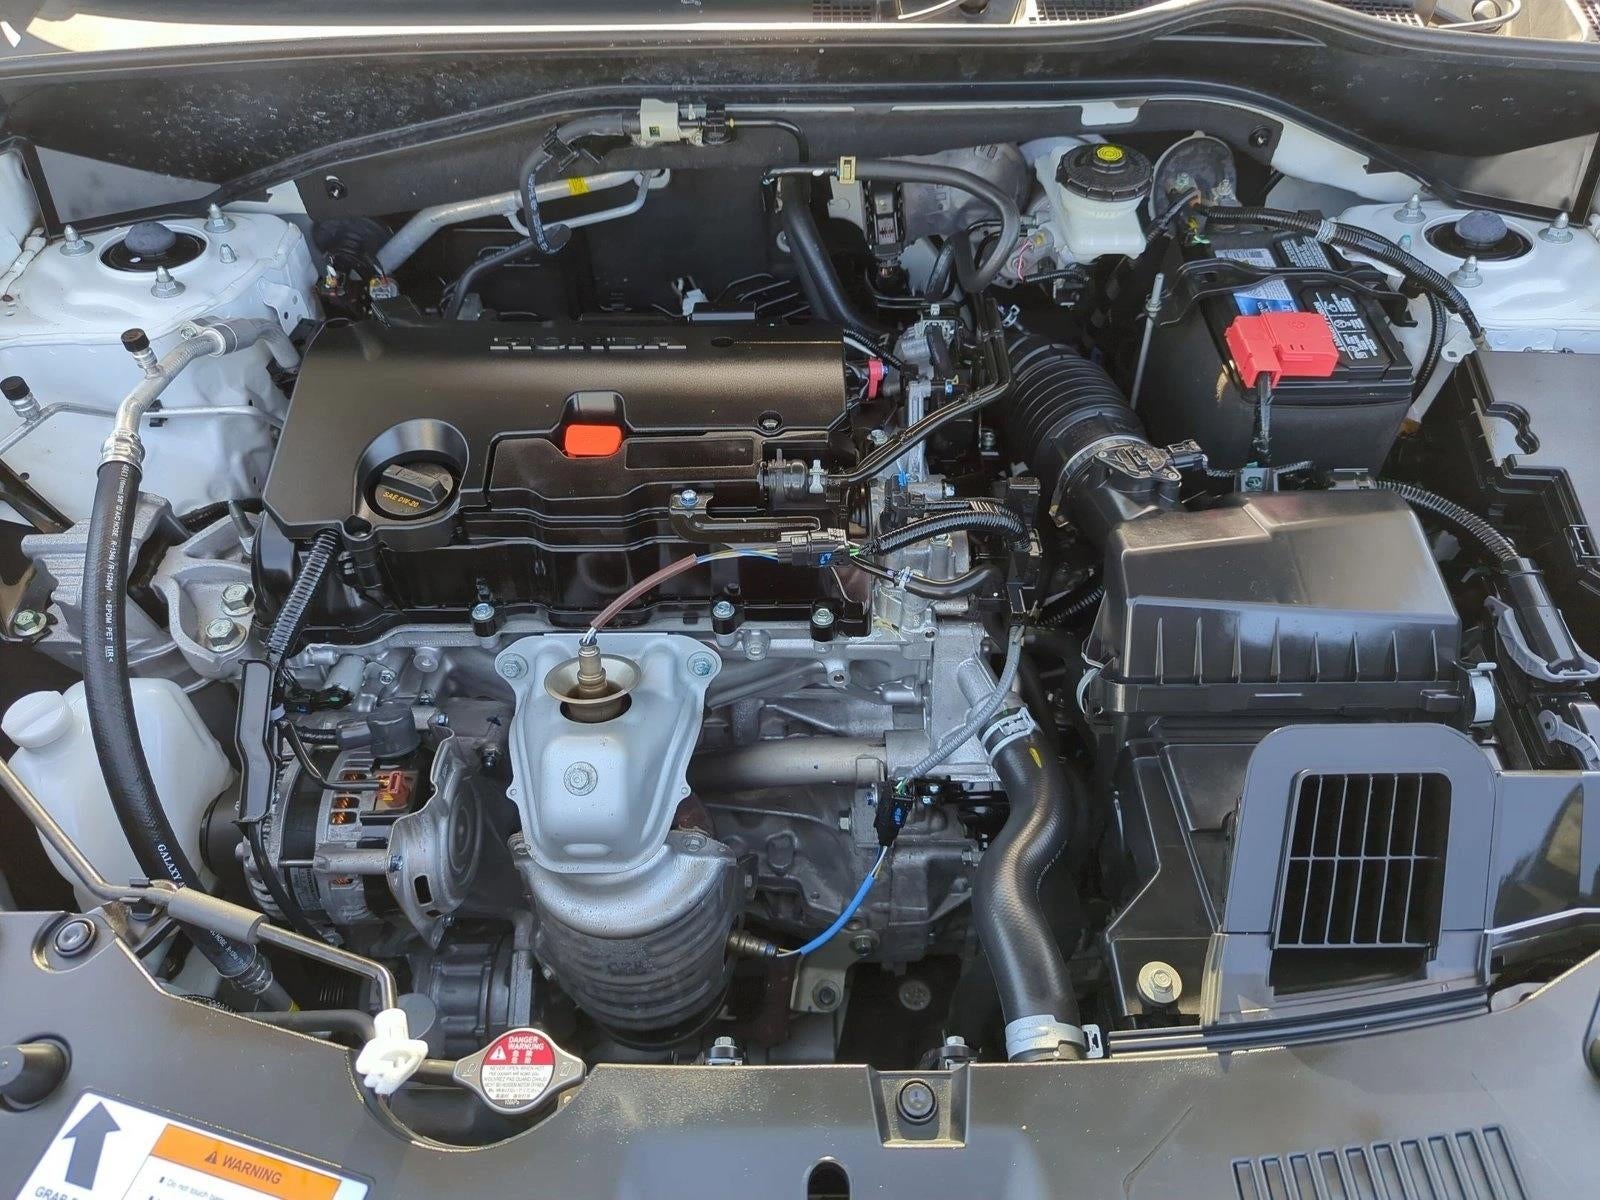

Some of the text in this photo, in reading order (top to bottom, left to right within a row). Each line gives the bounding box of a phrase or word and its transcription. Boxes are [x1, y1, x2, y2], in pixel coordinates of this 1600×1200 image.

[382, 491, 420, 508] SAE 0W-20
[111, 521, 120, 537] HOSE
[105, 627, 113, 641] PET
[157, 843, 183, 880] GALAXY
[508, 1036, 539, 1044] DANGER
[222, 1154, 282, 1186] WARNING
[166, 1178, 177, 1188] Do
[178, 1183, 189, 1192] not
